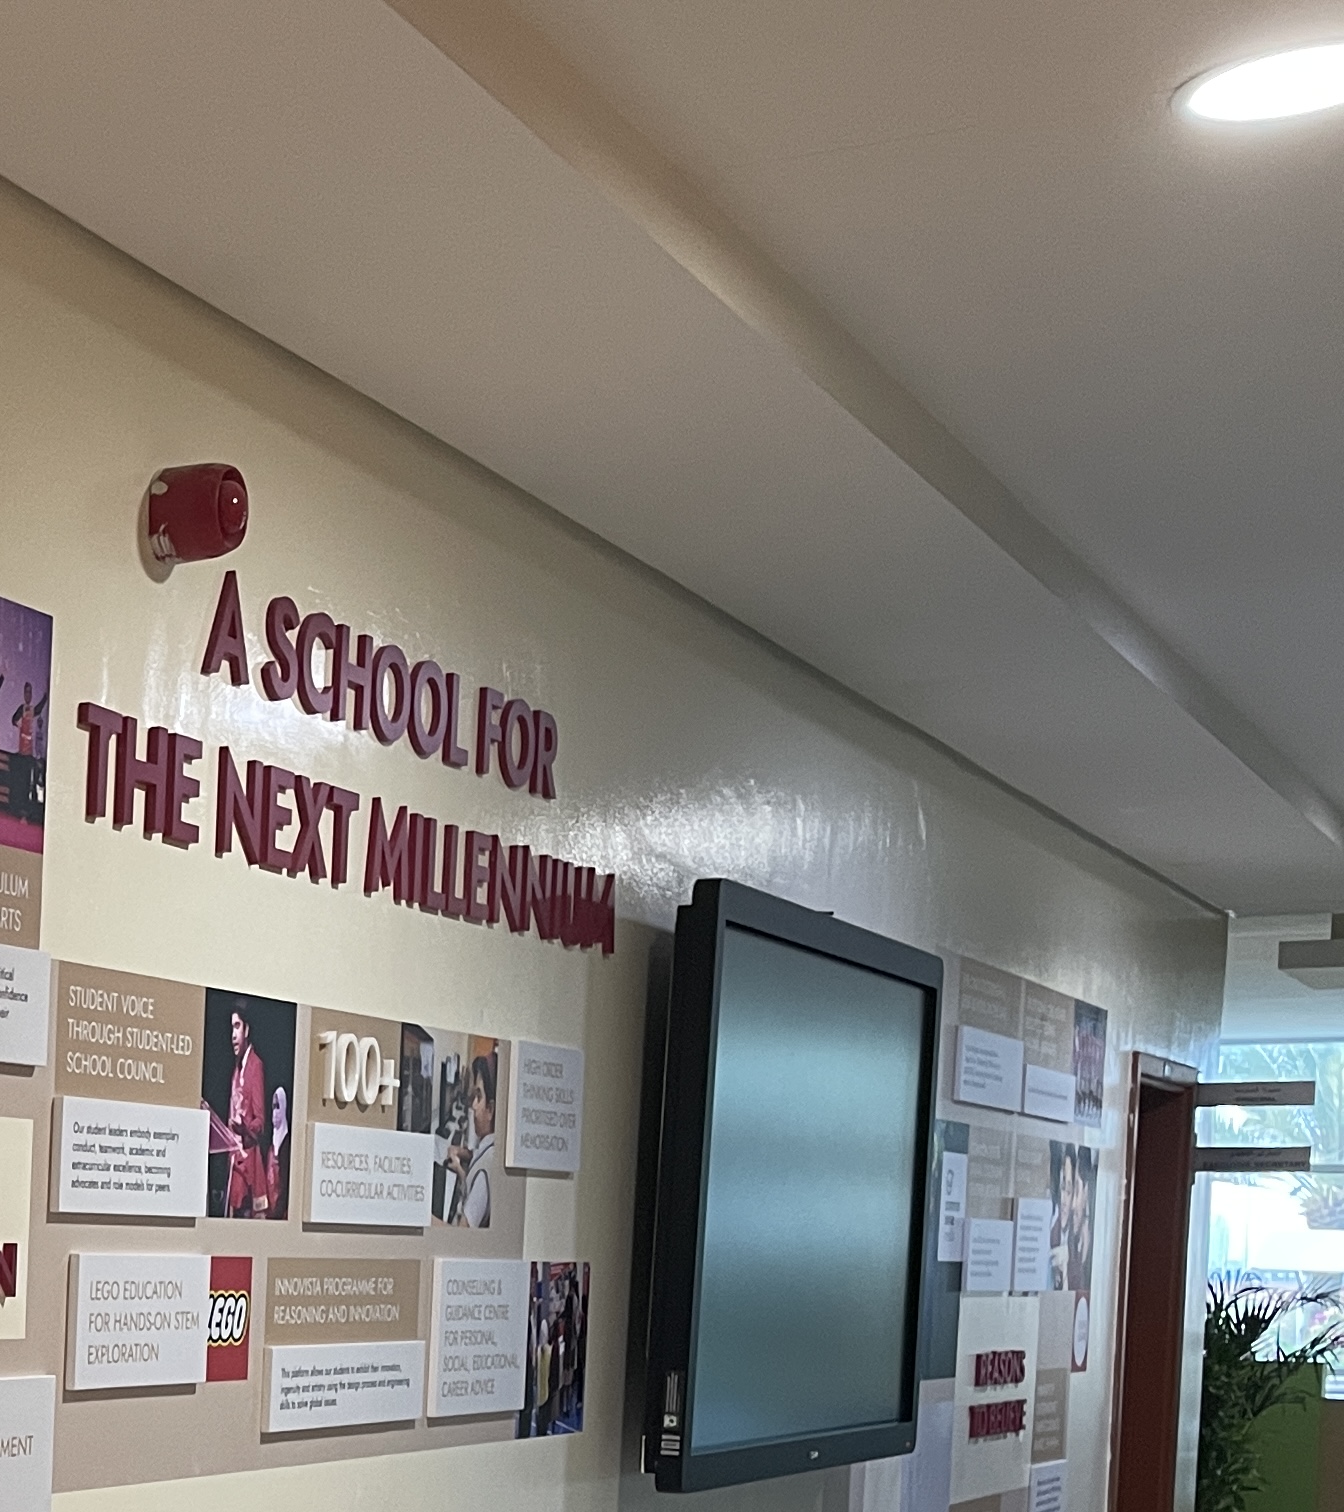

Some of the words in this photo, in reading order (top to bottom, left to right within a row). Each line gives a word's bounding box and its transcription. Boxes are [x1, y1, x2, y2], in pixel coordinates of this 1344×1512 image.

[200, 569, 250, 687] A
[260, 596, 467, 768] SCHOOL
[474, 686, 556, 799] FOR
[76, 701, 203, 850] THE
[214, 746, 360, 888] NEXT
[68, 985, 119, 1013] STUDENT
[120, 994, 155, 1019] VOICE
[65, 1052, 114, 1078] SCHOOL
[116, 1058, 165, 1084] COUNCIL
[317, 1029, 401, 1107] 100+
[89, 1280, 120, 1301] LEGO
[122, 1279, 183, 1301] EDUCATION
[88, 1313, 111, 1333] FOR
[112, 1311, 171, 1332] HANDS-ON
[173, 1310, 199, 1331] STEM
[86, 1342, 159, 1365] EXPLORATION
